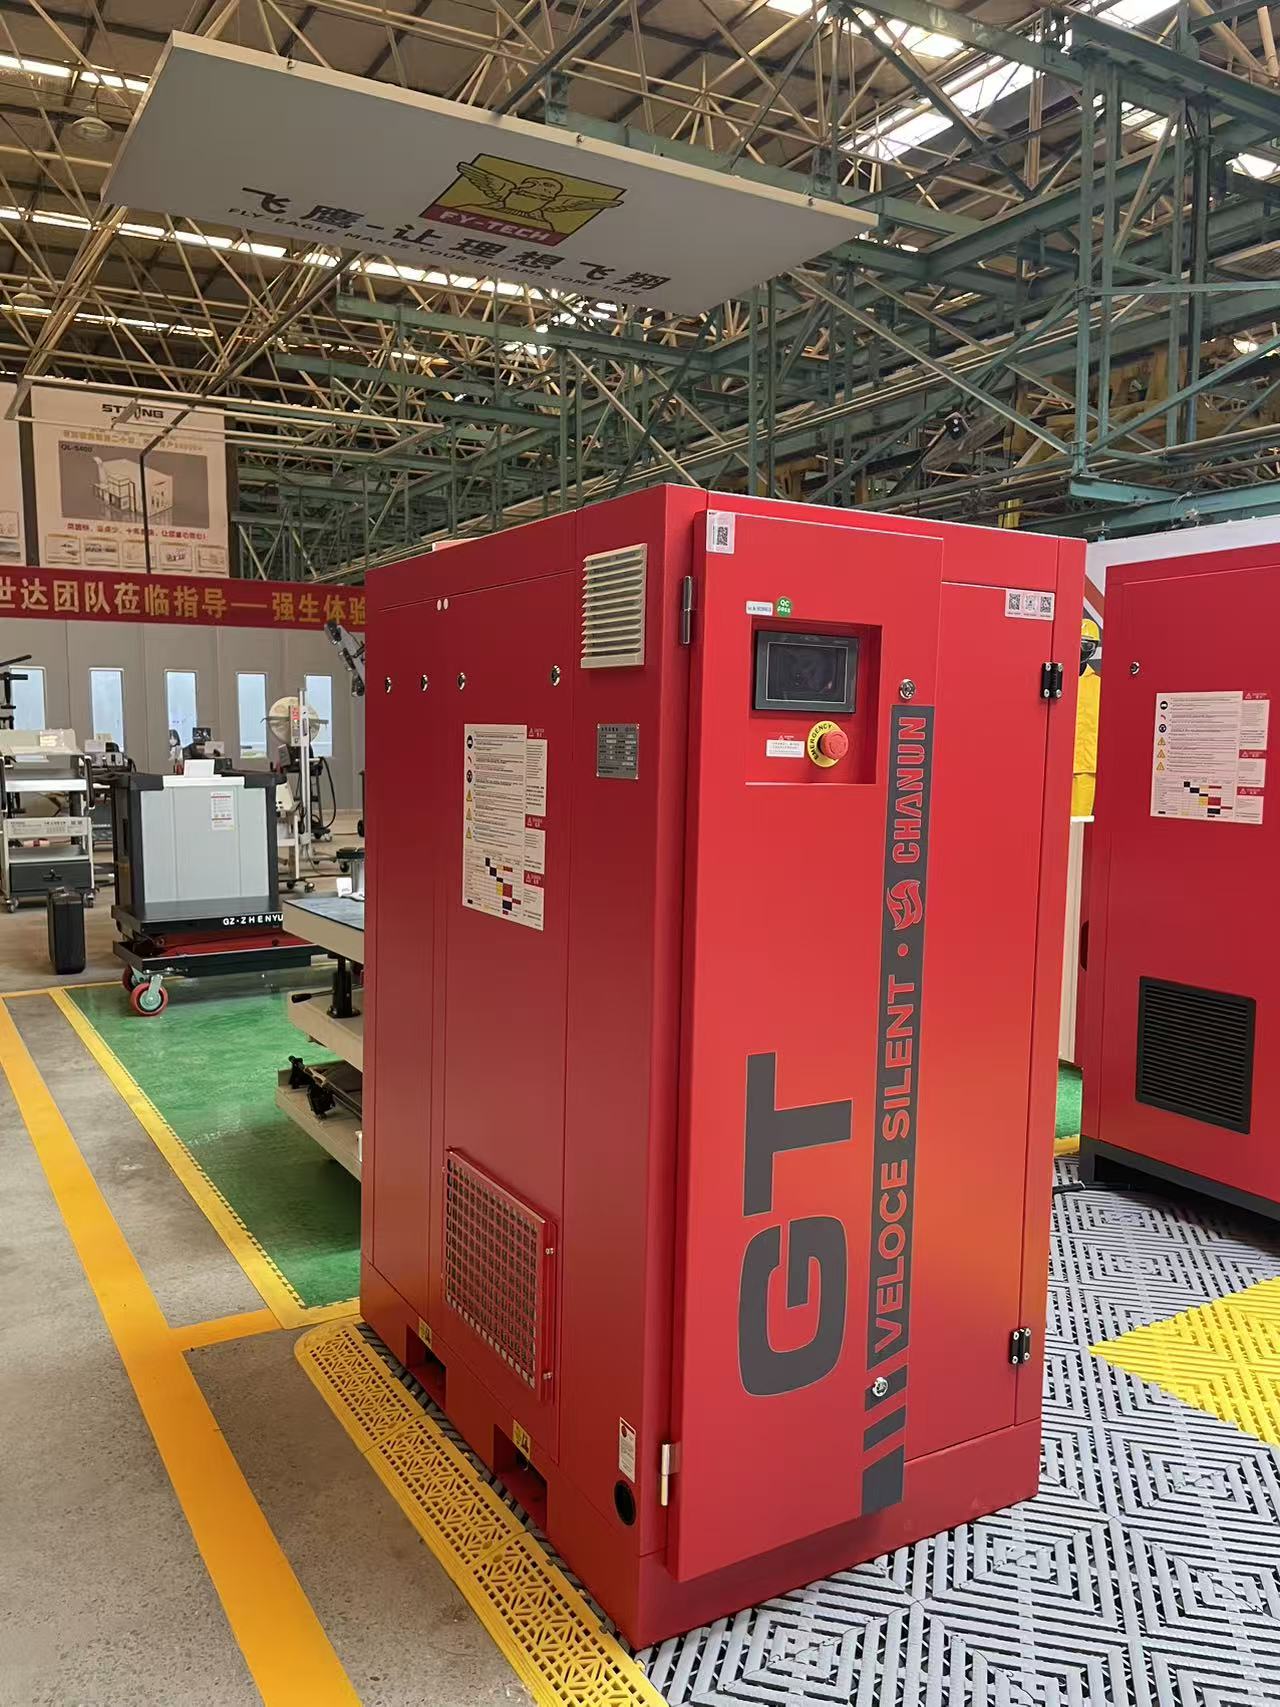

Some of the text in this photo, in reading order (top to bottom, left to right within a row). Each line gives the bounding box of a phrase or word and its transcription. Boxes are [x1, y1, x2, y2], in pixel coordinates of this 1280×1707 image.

[228, 207, 643, 295] FLY-EAGLE MAKES YOUR DREAMS COME TRUE
[439, 210, 552, 241] FY-TECH
[810, 722, 832, 760] EMERGENCY
[875, 716, 926, 1353] VELOCE SILENT CHANUN
[737, 1051, 853, 1397] GT
